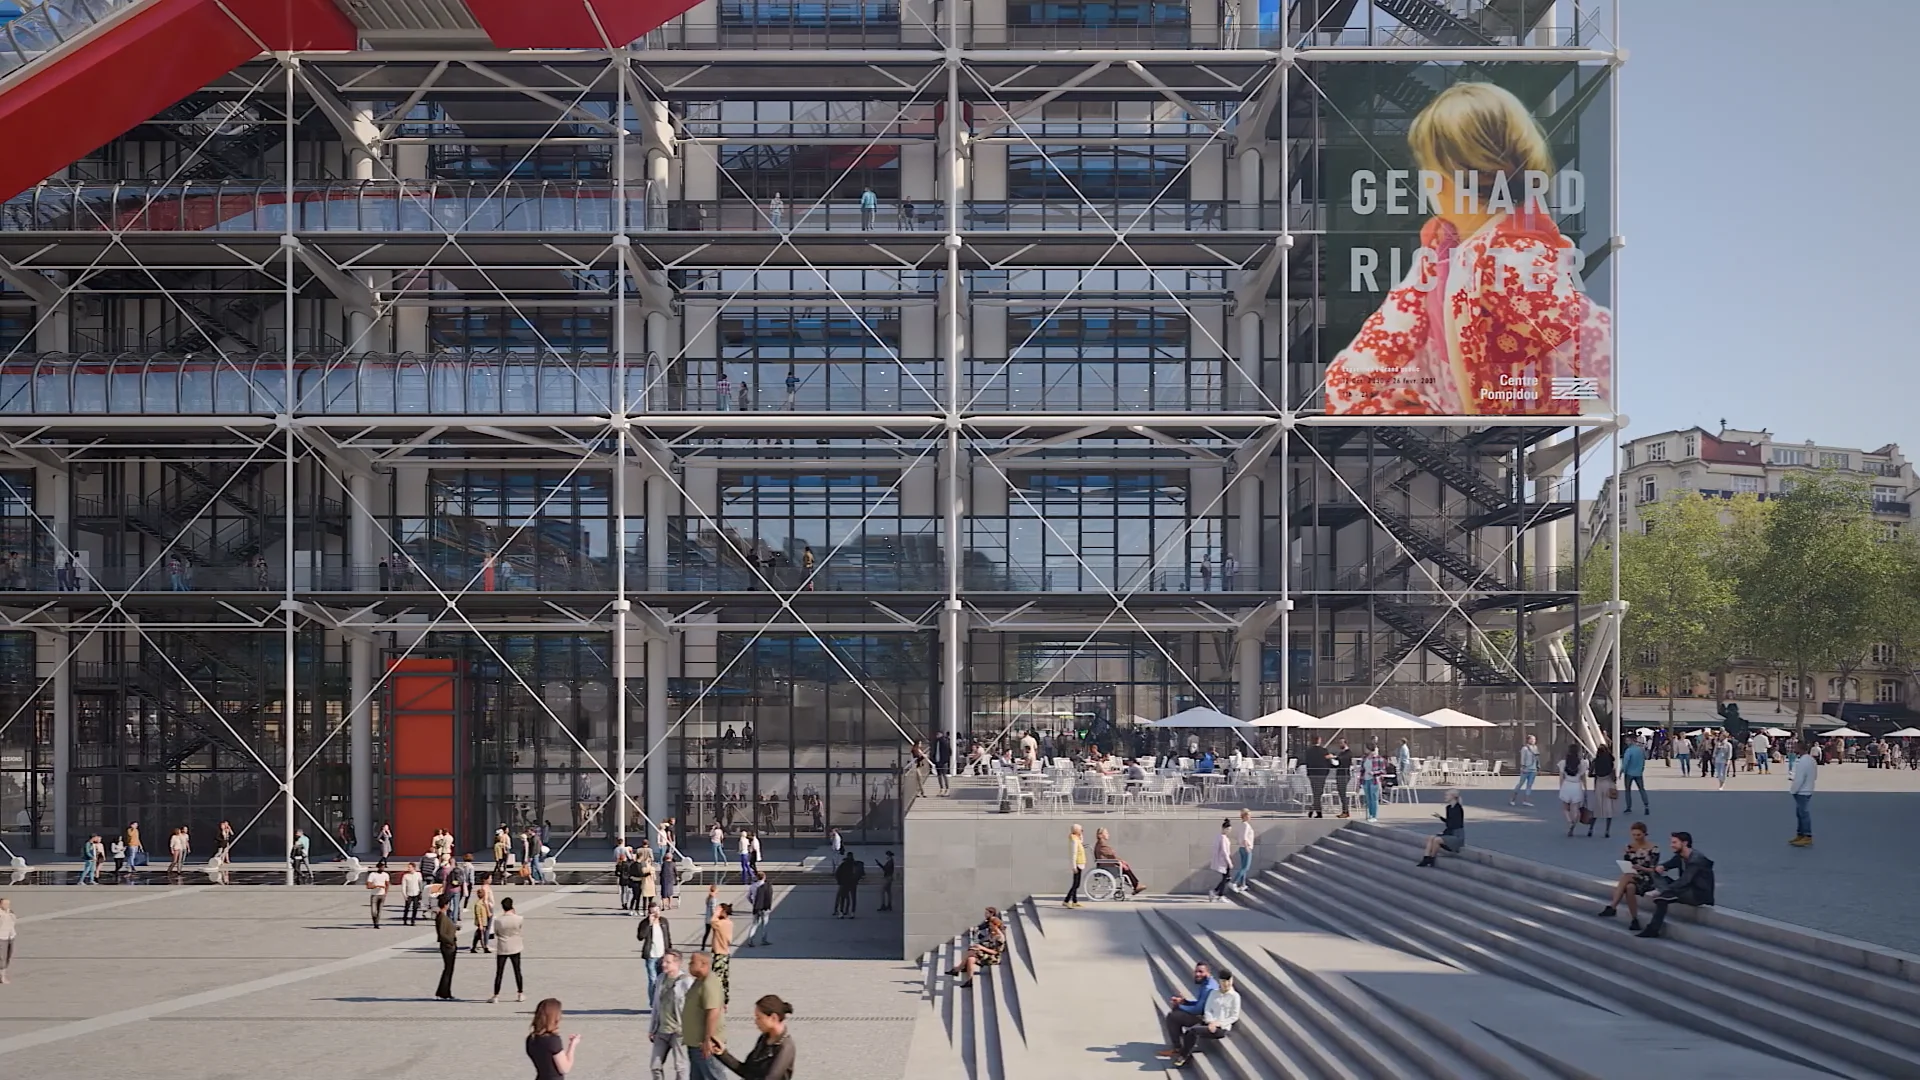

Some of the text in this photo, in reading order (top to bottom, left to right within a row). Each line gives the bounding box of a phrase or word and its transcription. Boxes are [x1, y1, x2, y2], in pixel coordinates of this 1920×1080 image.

[1351, 169, 1586, 215] GERHARD
[1500, 374, 1539, 386] Centre
[1480, 388, 1539, 402] Pompidou
